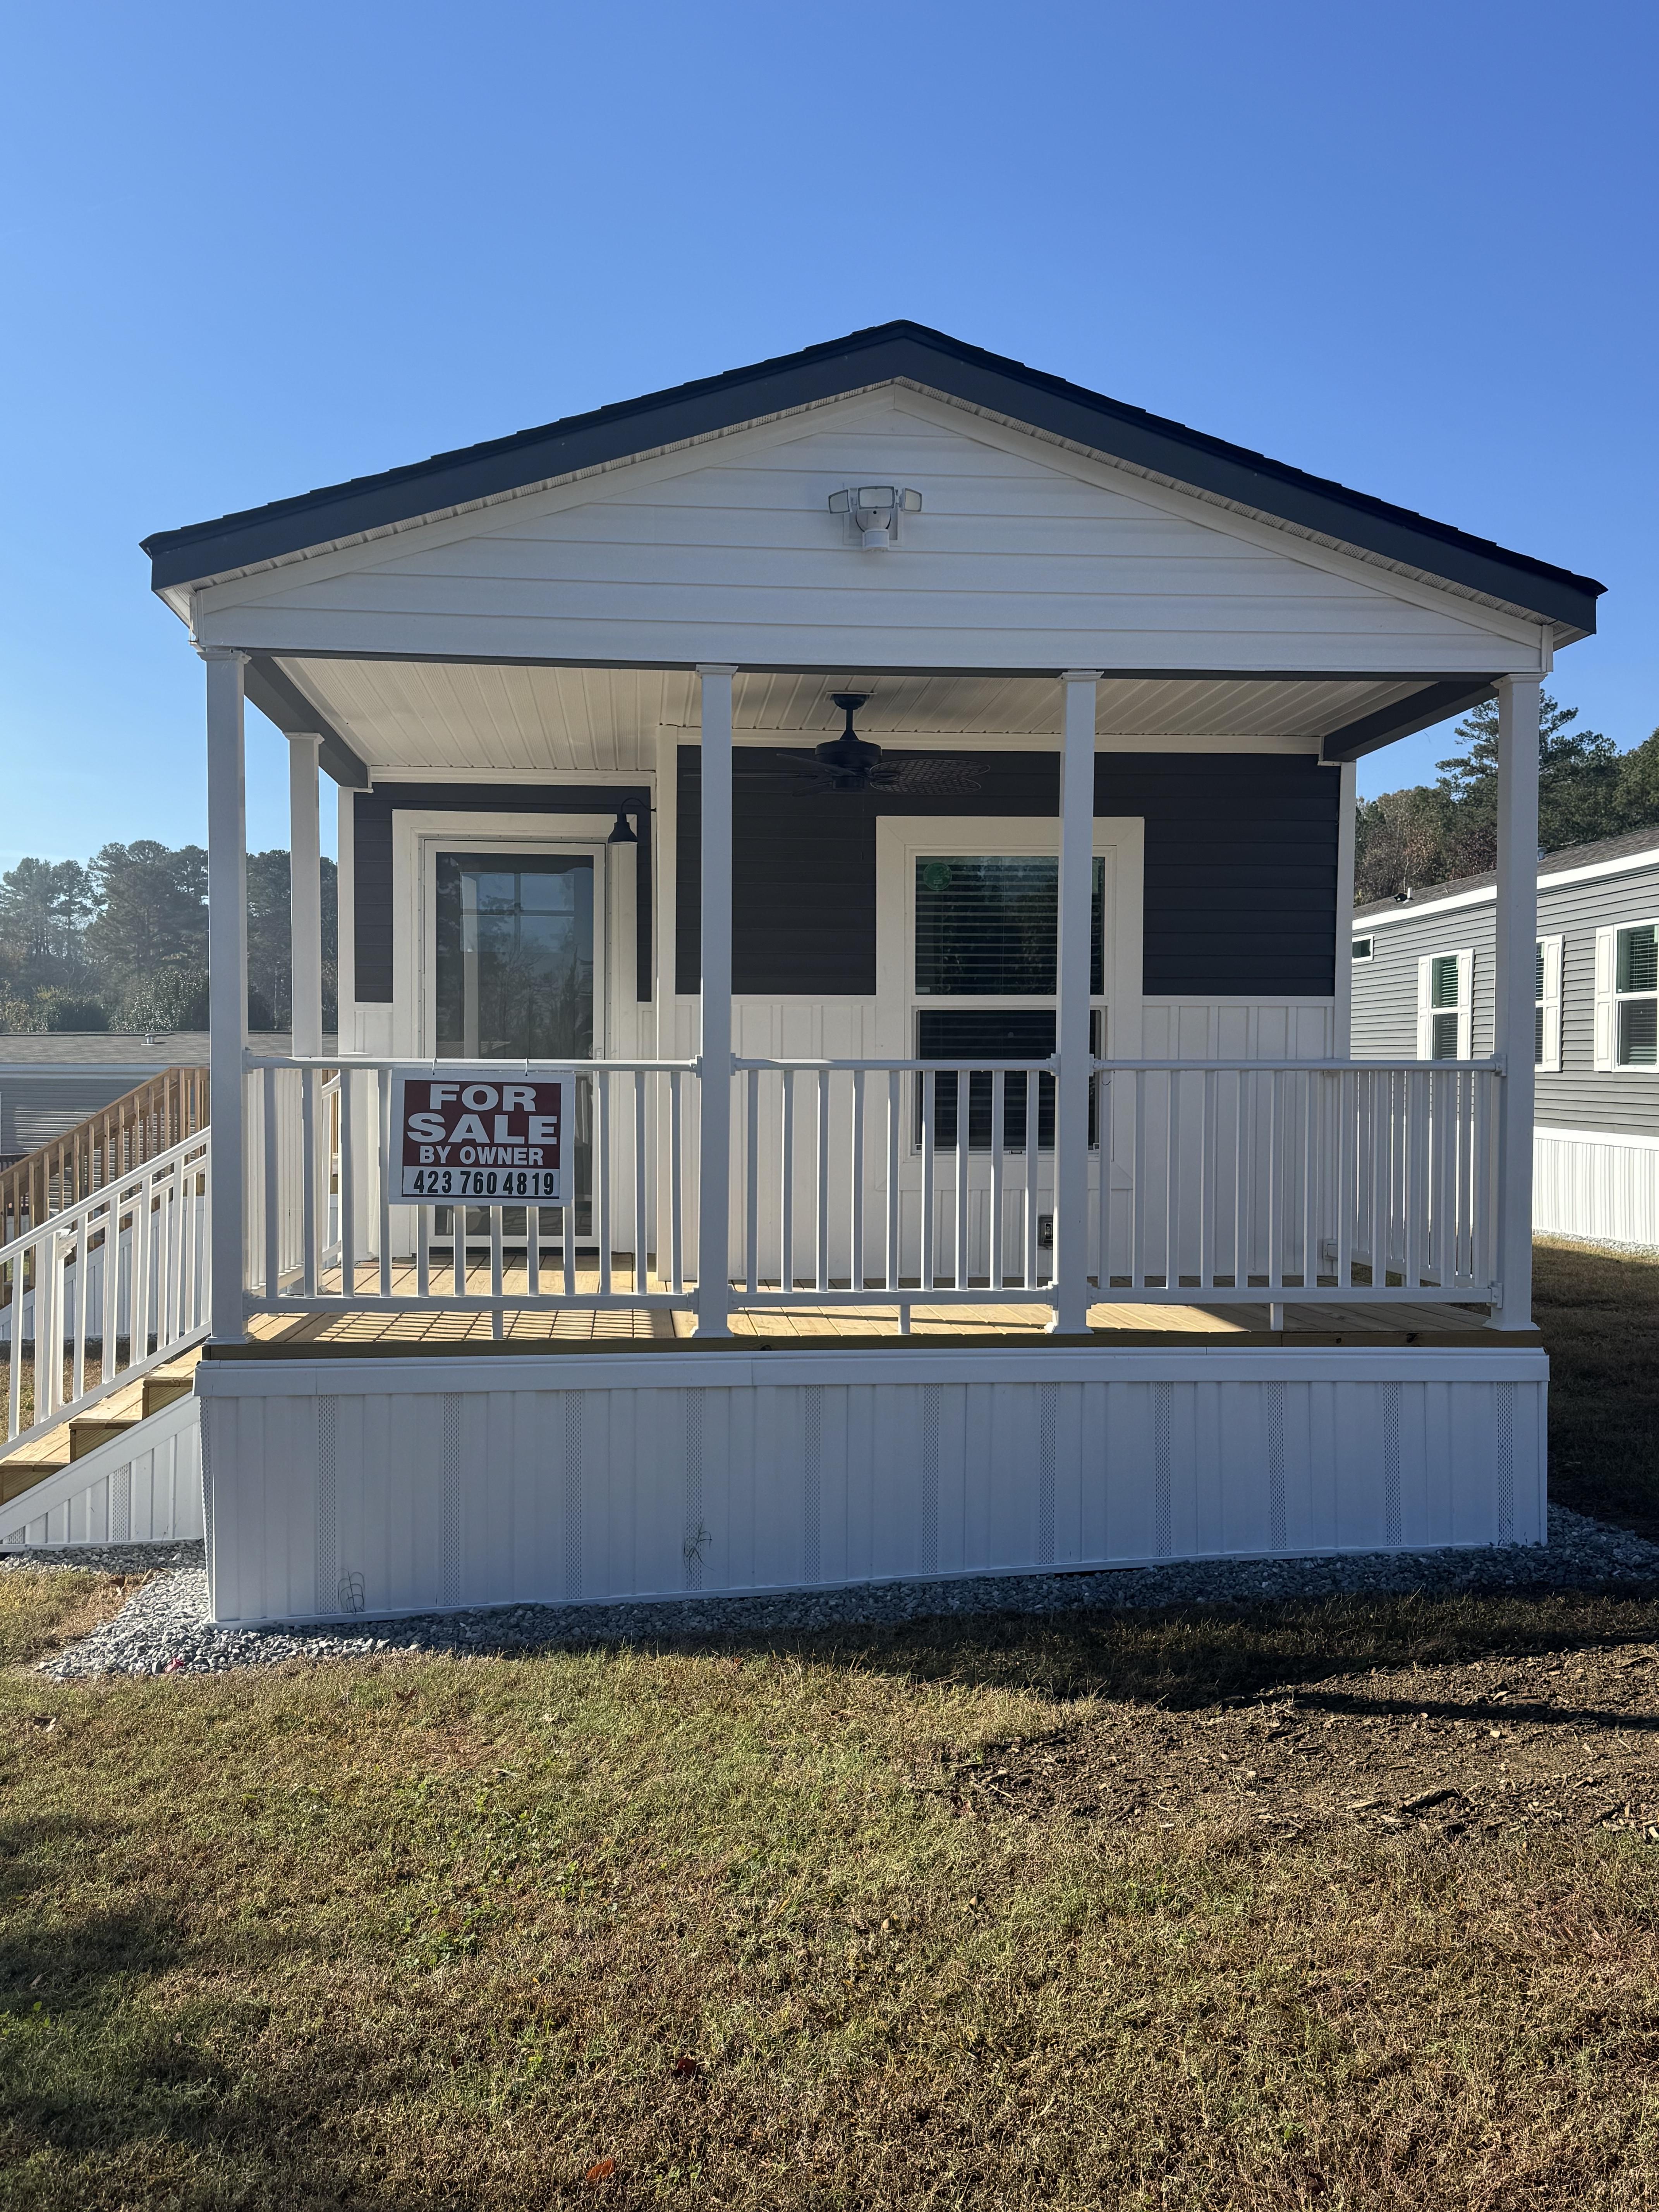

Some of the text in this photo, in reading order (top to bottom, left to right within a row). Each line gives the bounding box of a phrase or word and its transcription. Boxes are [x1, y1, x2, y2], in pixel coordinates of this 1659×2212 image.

[430, 1084, 536, 1111] FOR
[407, 1113, 557, 1144] SALE
[420, 1146, 543, 1165] BY OWNER
[413, 1170, 554, 1195] 423 760 4819
